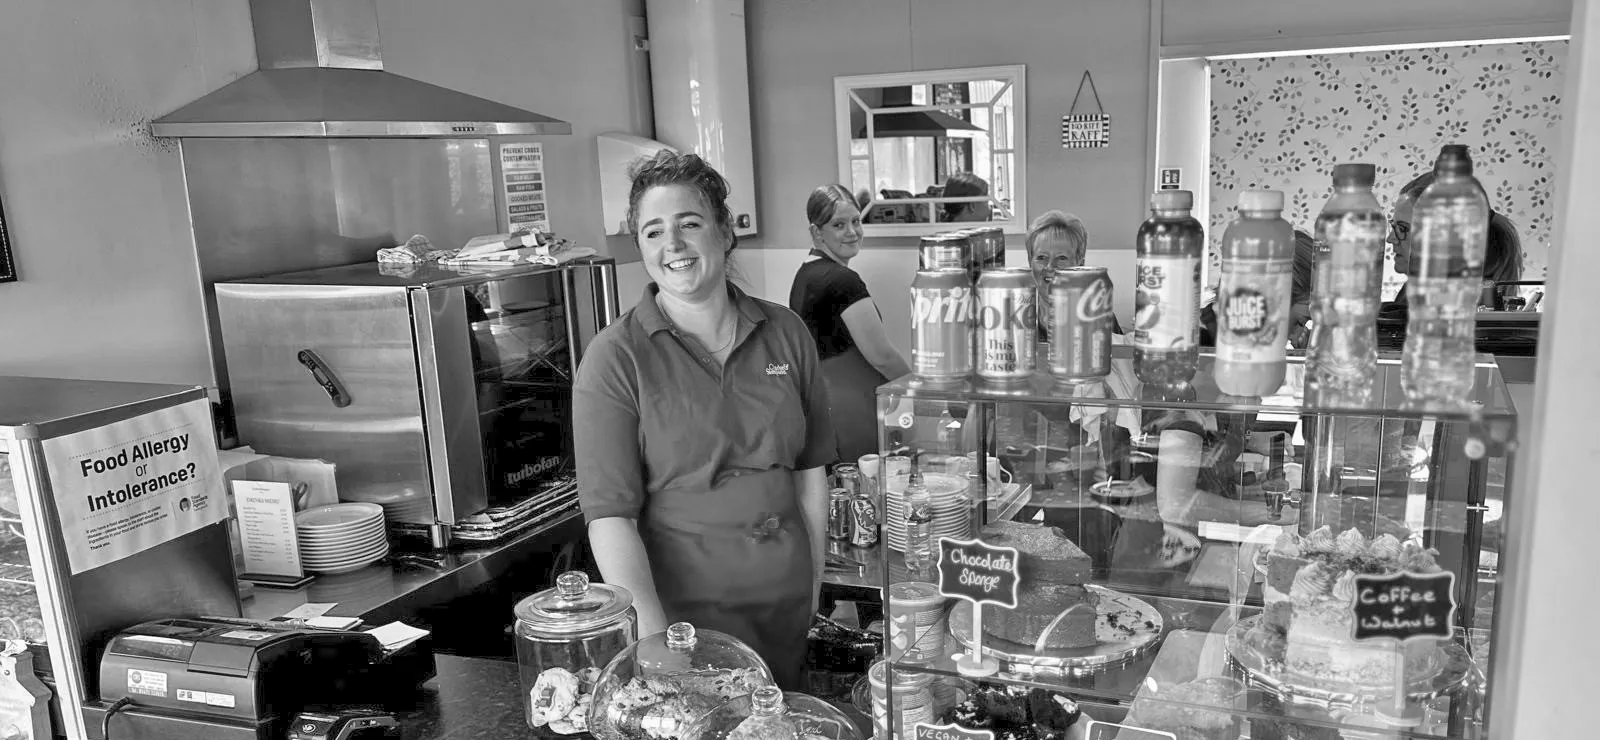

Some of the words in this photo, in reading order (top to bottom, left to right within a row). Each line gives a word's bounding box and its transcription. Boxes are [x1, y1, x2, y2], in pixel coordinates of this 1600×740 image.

[979, 296, 1037, 330] oke
[1227, 295, 1265, 315] JUICE
[80, 449, 128, 477] Food
[132, 433, 189, 463] Allergy
[135, 463, 148, 477] or
[507, 456, 560, 485] turbofan
[87, 462, 196, 512] Intolerance?
[951, 548, 1012, 572] Chocolate
